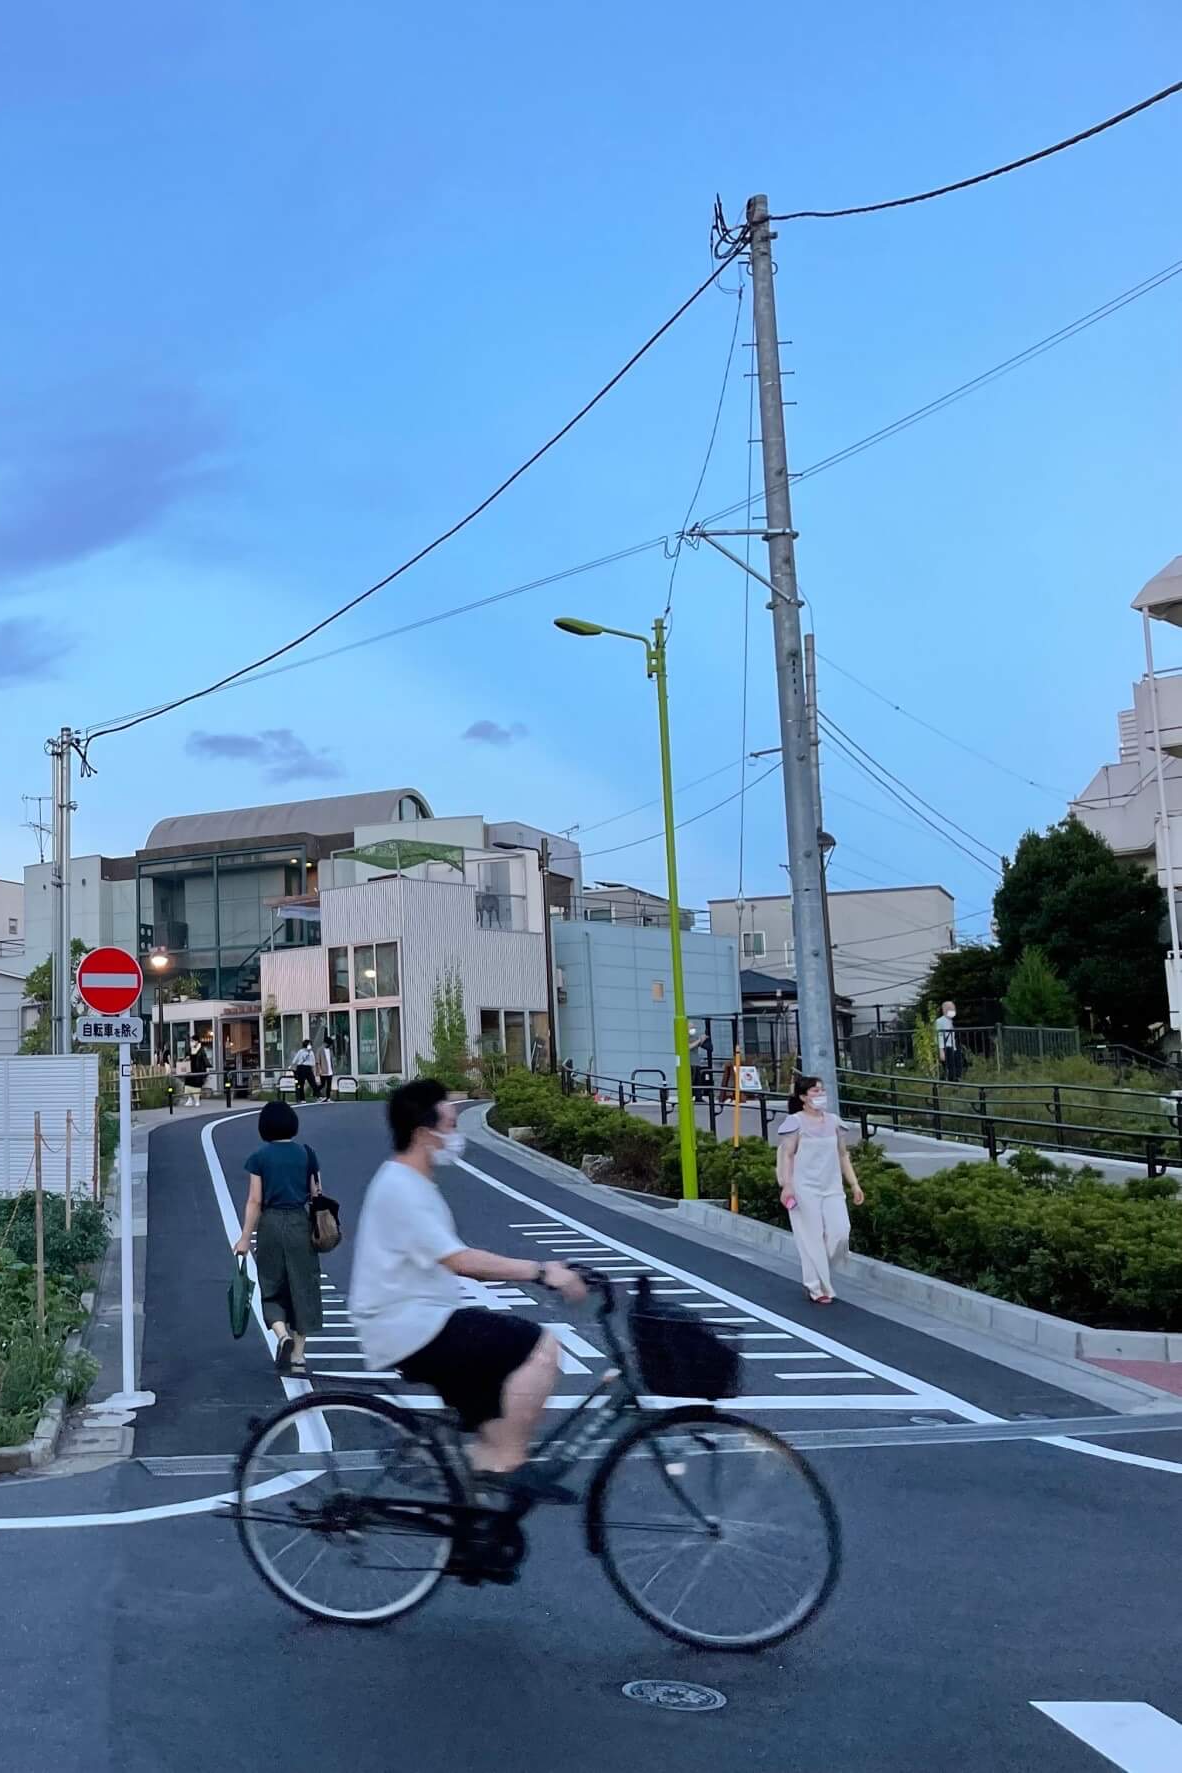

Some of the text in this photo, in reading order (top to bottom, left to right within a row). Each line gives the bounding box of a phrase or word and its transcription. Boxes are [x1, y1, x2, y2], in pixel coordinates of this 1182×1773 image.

[83, 1023, 138, 1038] 自転車を除く
